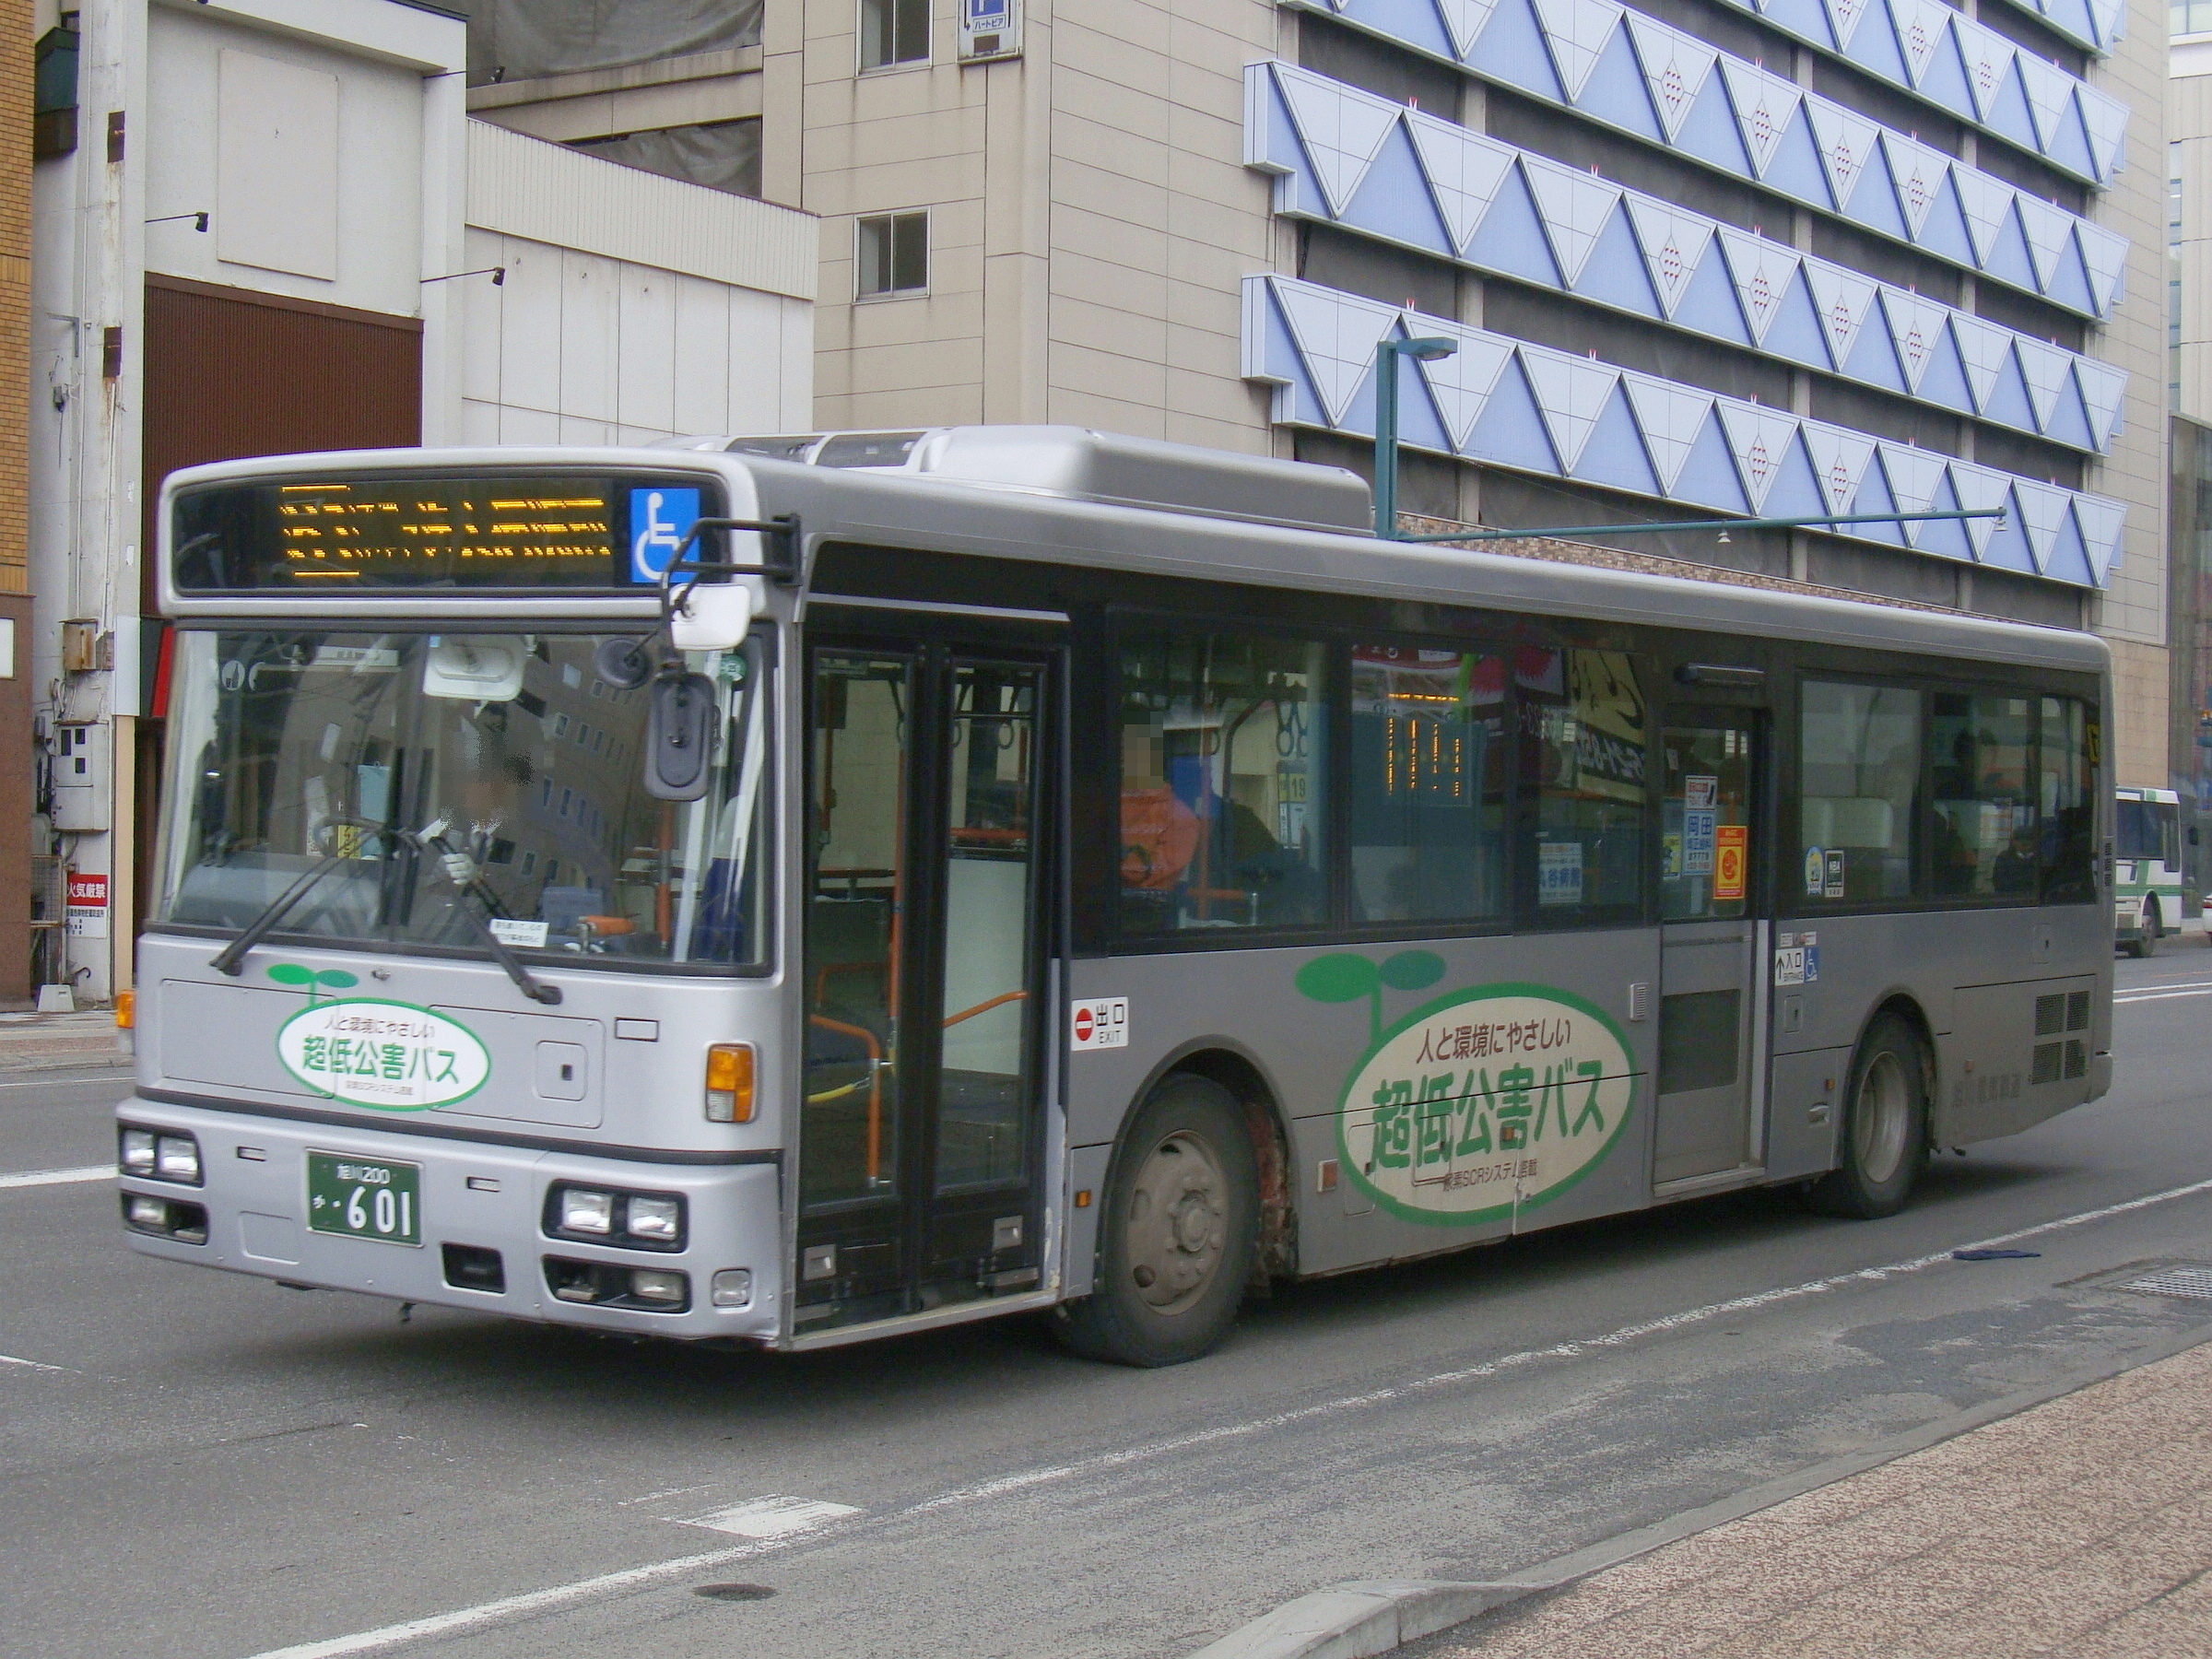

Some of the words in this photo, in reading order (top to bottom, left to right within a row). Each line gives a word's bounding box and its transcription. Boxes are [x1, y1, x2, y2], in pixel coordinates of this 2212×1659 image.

[974, 18, 1004, 29] ハートピア
[67, 882, 106, 899] 火気厳禁
[1785, 952, 1803, 970] 入口
[324, 1015, 435, 1038] 人と環境にやさしい
[1096, 1003, 1124, 1027] 出口
[1100, 1030, 1122, 1044] EXIT
[1417, 1018, 1571, 1065] 人と環境にやさしい
[302, 1033, 460, 1085] 超低公害バス
[1369, 1061, 1605, 1173] 超低公害バス
